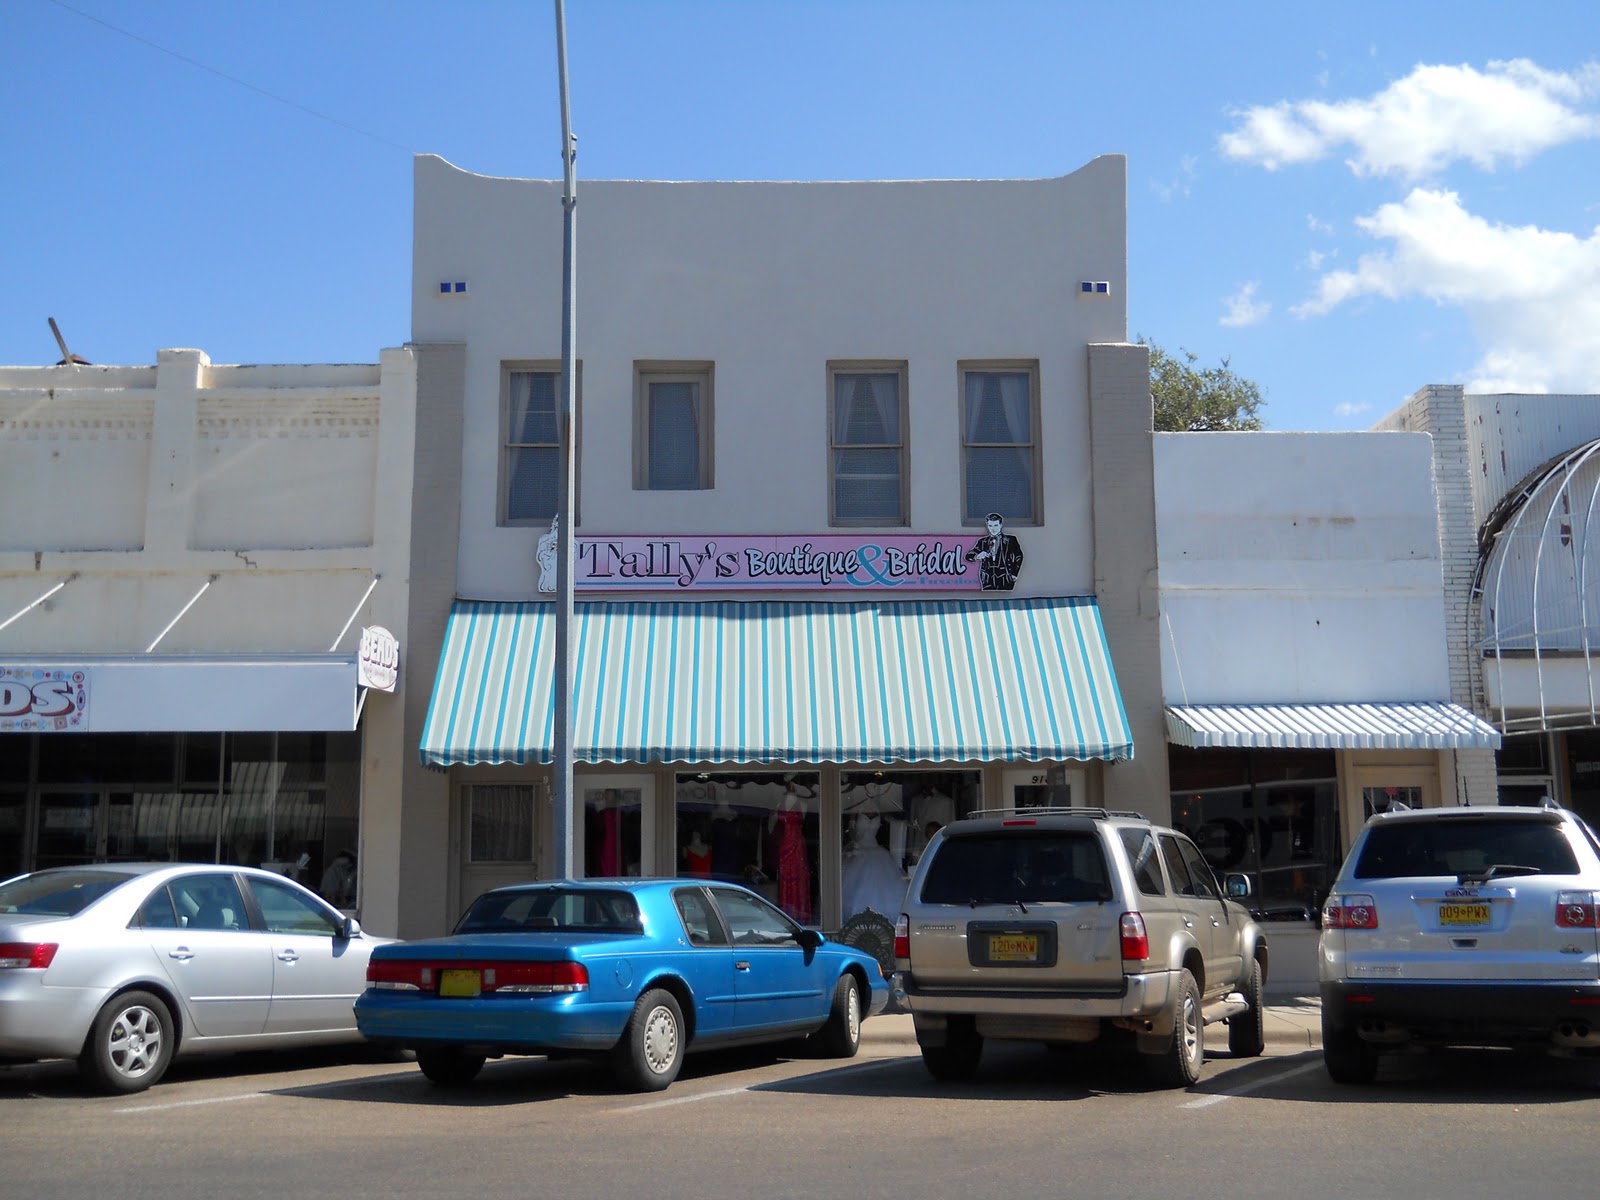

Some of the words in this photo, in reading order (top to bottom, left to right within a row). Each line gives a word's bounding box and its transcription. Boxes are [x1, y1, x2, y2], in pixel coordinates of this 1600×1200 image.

[579, 541, 741, 587] Tally's
[746, 543, 859, 585] Boutique
[846, 544, 905, 587] &
[886, 542, 967, 576] Bridal
[1031, 775, 1048, 784] 91
[1444, 887, 1479, 897] GMC
